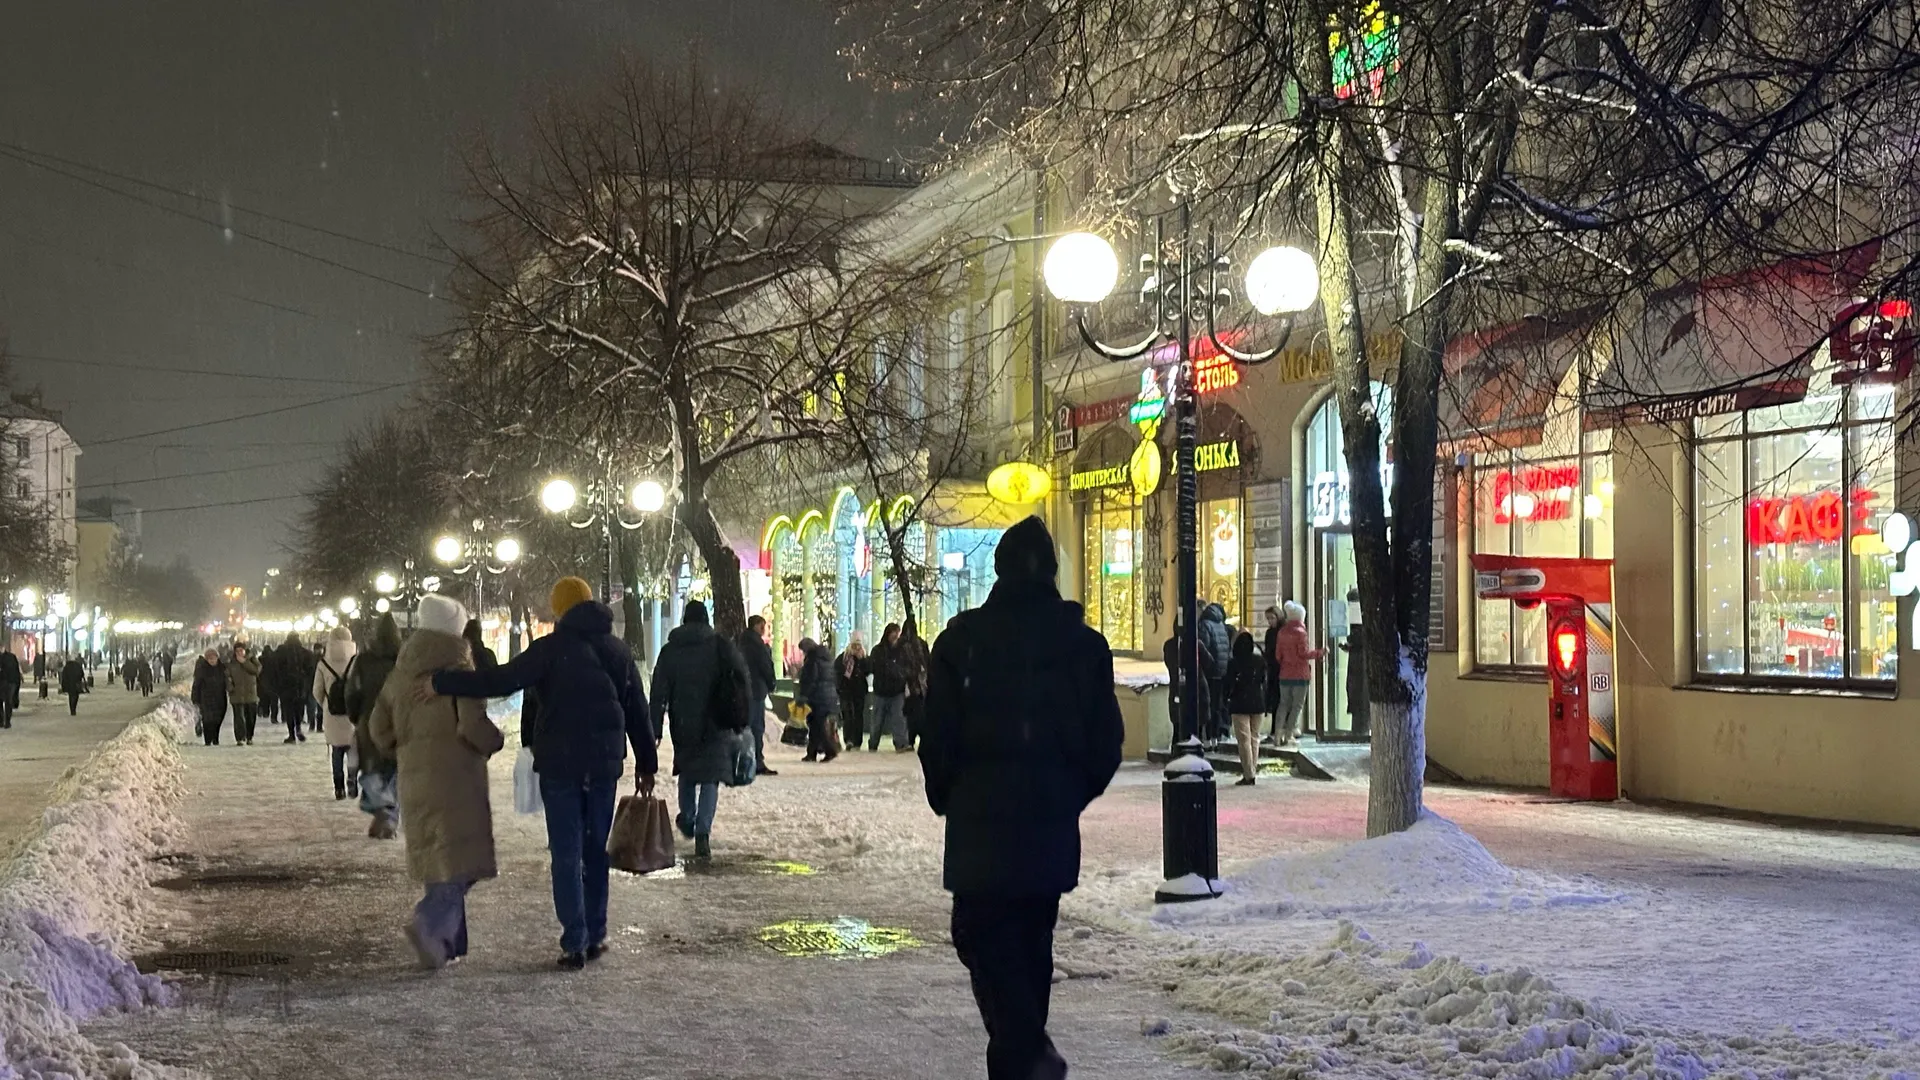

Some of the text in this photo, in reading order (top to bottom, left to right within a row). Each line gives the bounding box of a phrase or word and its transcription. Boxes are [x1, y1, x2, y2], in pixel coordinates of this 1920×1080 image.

[1697, 393, 1737, 415] СИТИ
[1070, 464, 1128, 490] КОНДИТЕРСКАЯ
[1757, 489, 1880, 546] КАФЕ
[1593, 676, 1608, 689] RB
